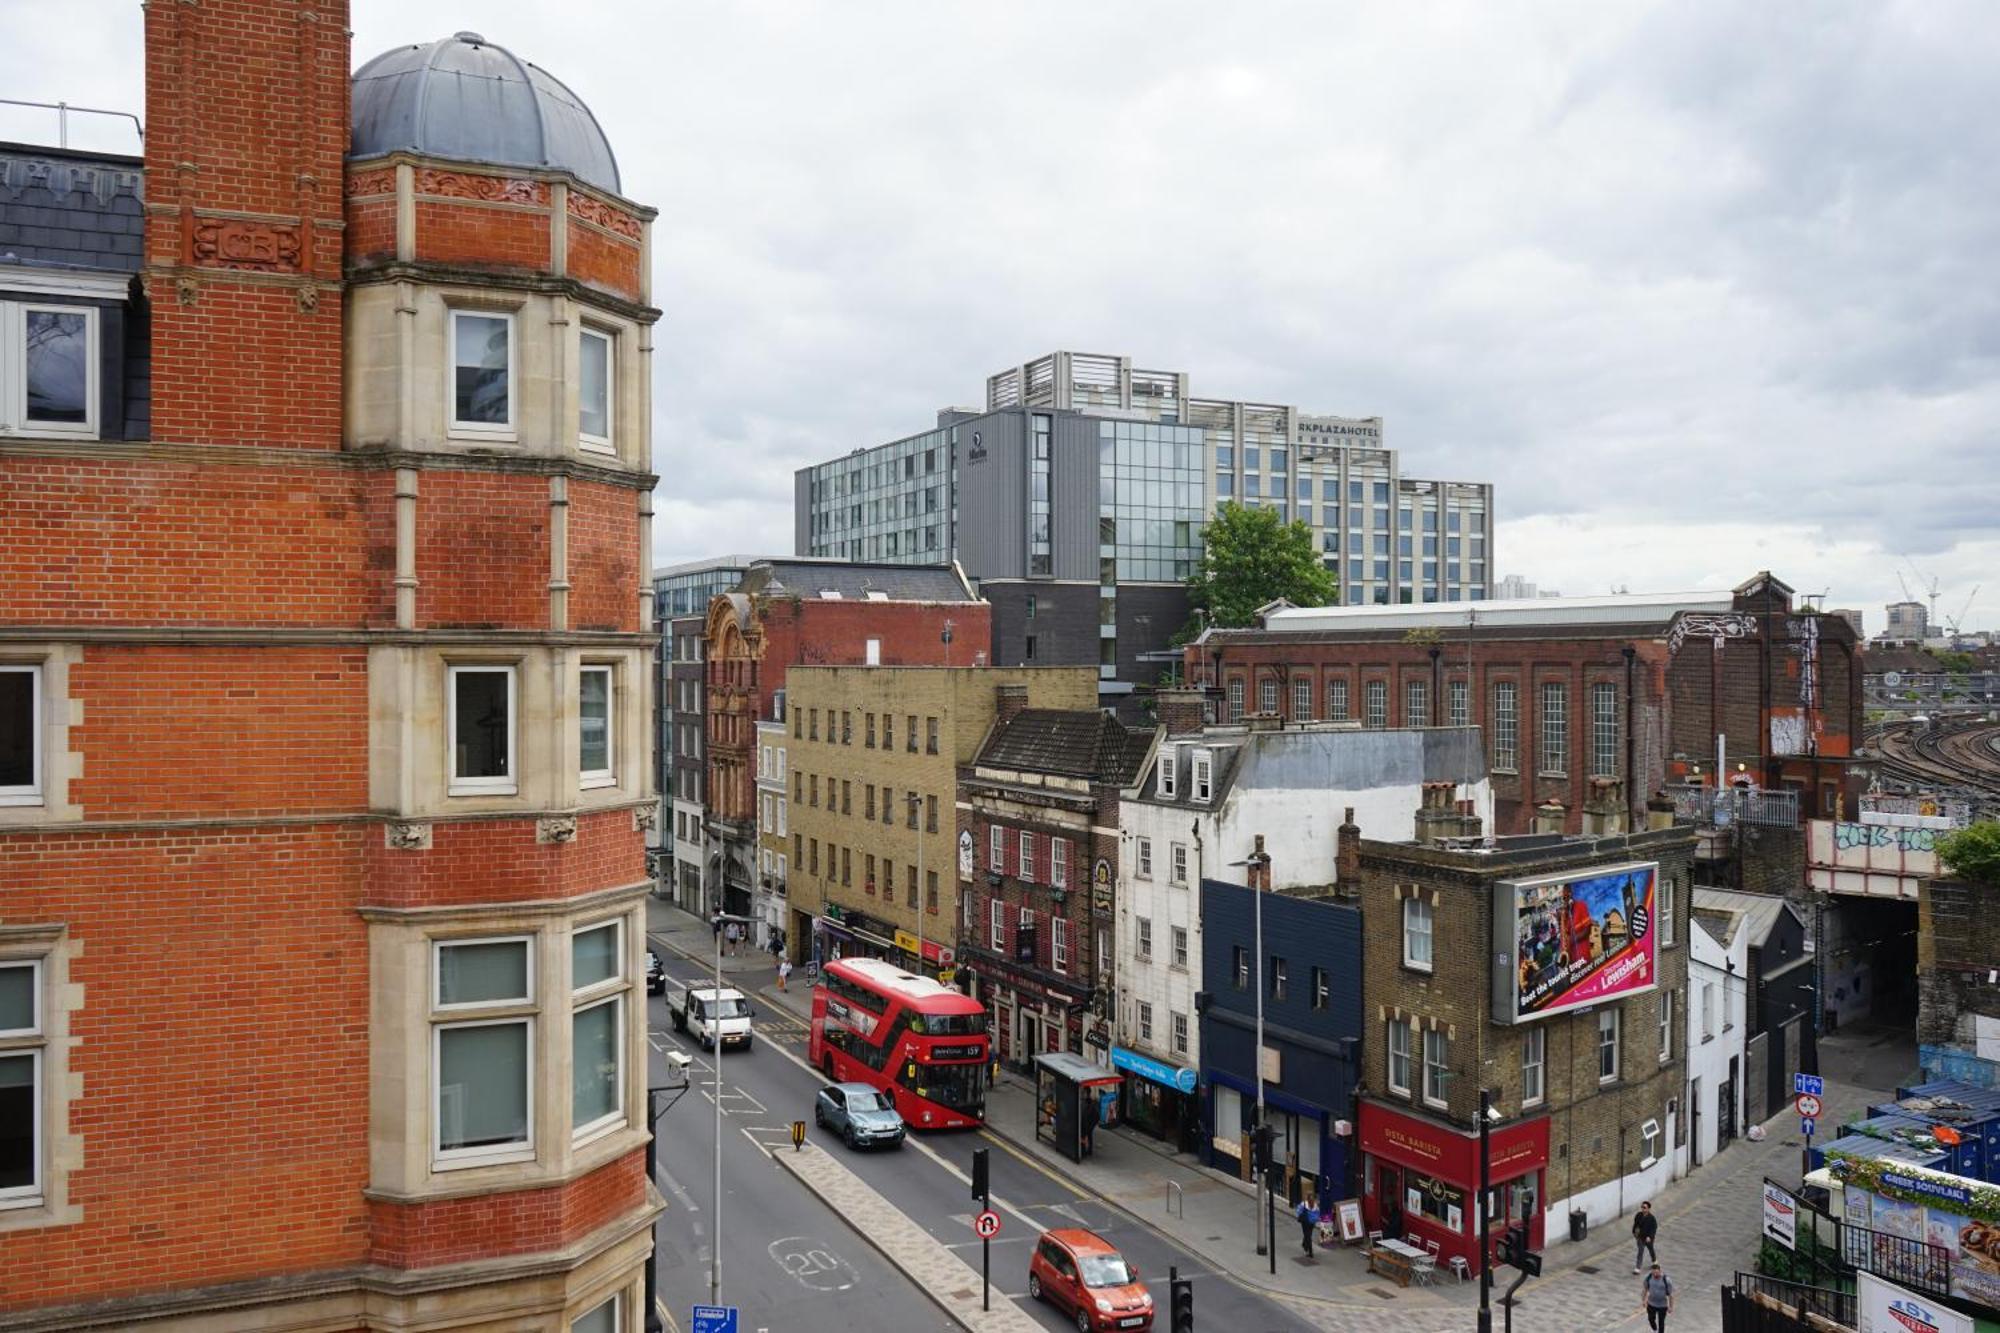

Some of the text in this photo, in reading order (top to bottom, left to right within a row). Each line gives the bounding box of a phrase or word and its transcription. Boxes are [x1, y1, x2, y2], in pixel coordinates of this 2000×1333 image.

[1601, 952, 1645, 990] Lewisham
[967, 1046, 979, 1056] 159
[1408, 1137, 1441, 1155] BARISTA
[1915, 1181, 1964, 1200] SOUVLAKI
[786, 1250, 838, 1276] 20
[1891, 1300, 1935, 1323] 1ST
